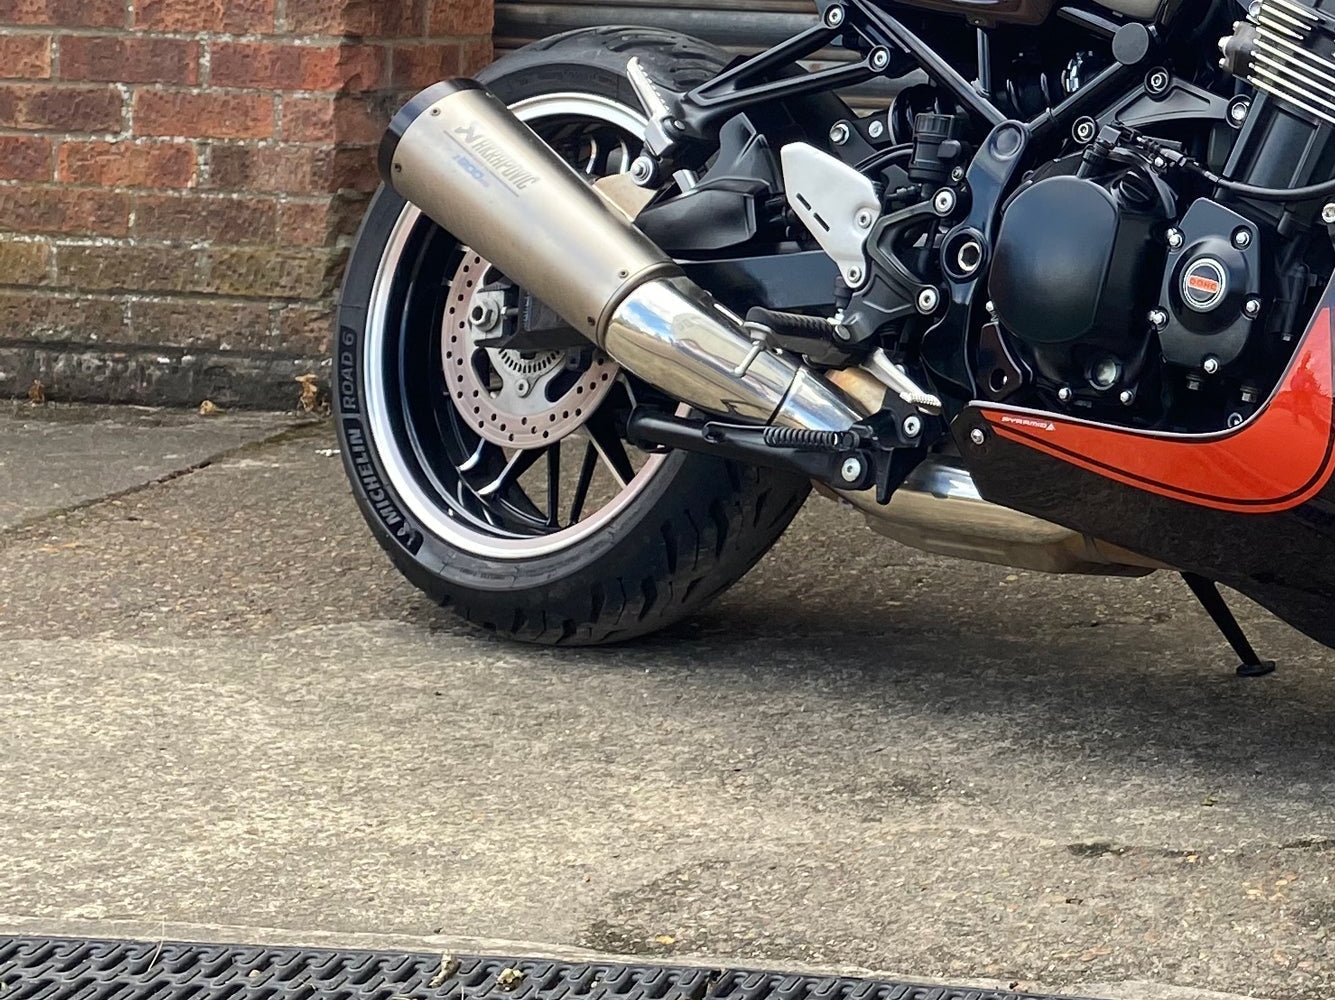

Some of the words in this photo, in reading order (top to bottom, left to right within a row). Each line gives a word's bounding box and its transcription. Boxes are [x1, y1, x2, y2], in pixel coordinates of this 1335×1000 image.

[341, 331, 355, 342] 6
[341, 352, 356, 409] ROAD
[347, 427, 401, 525] MICHELIN
